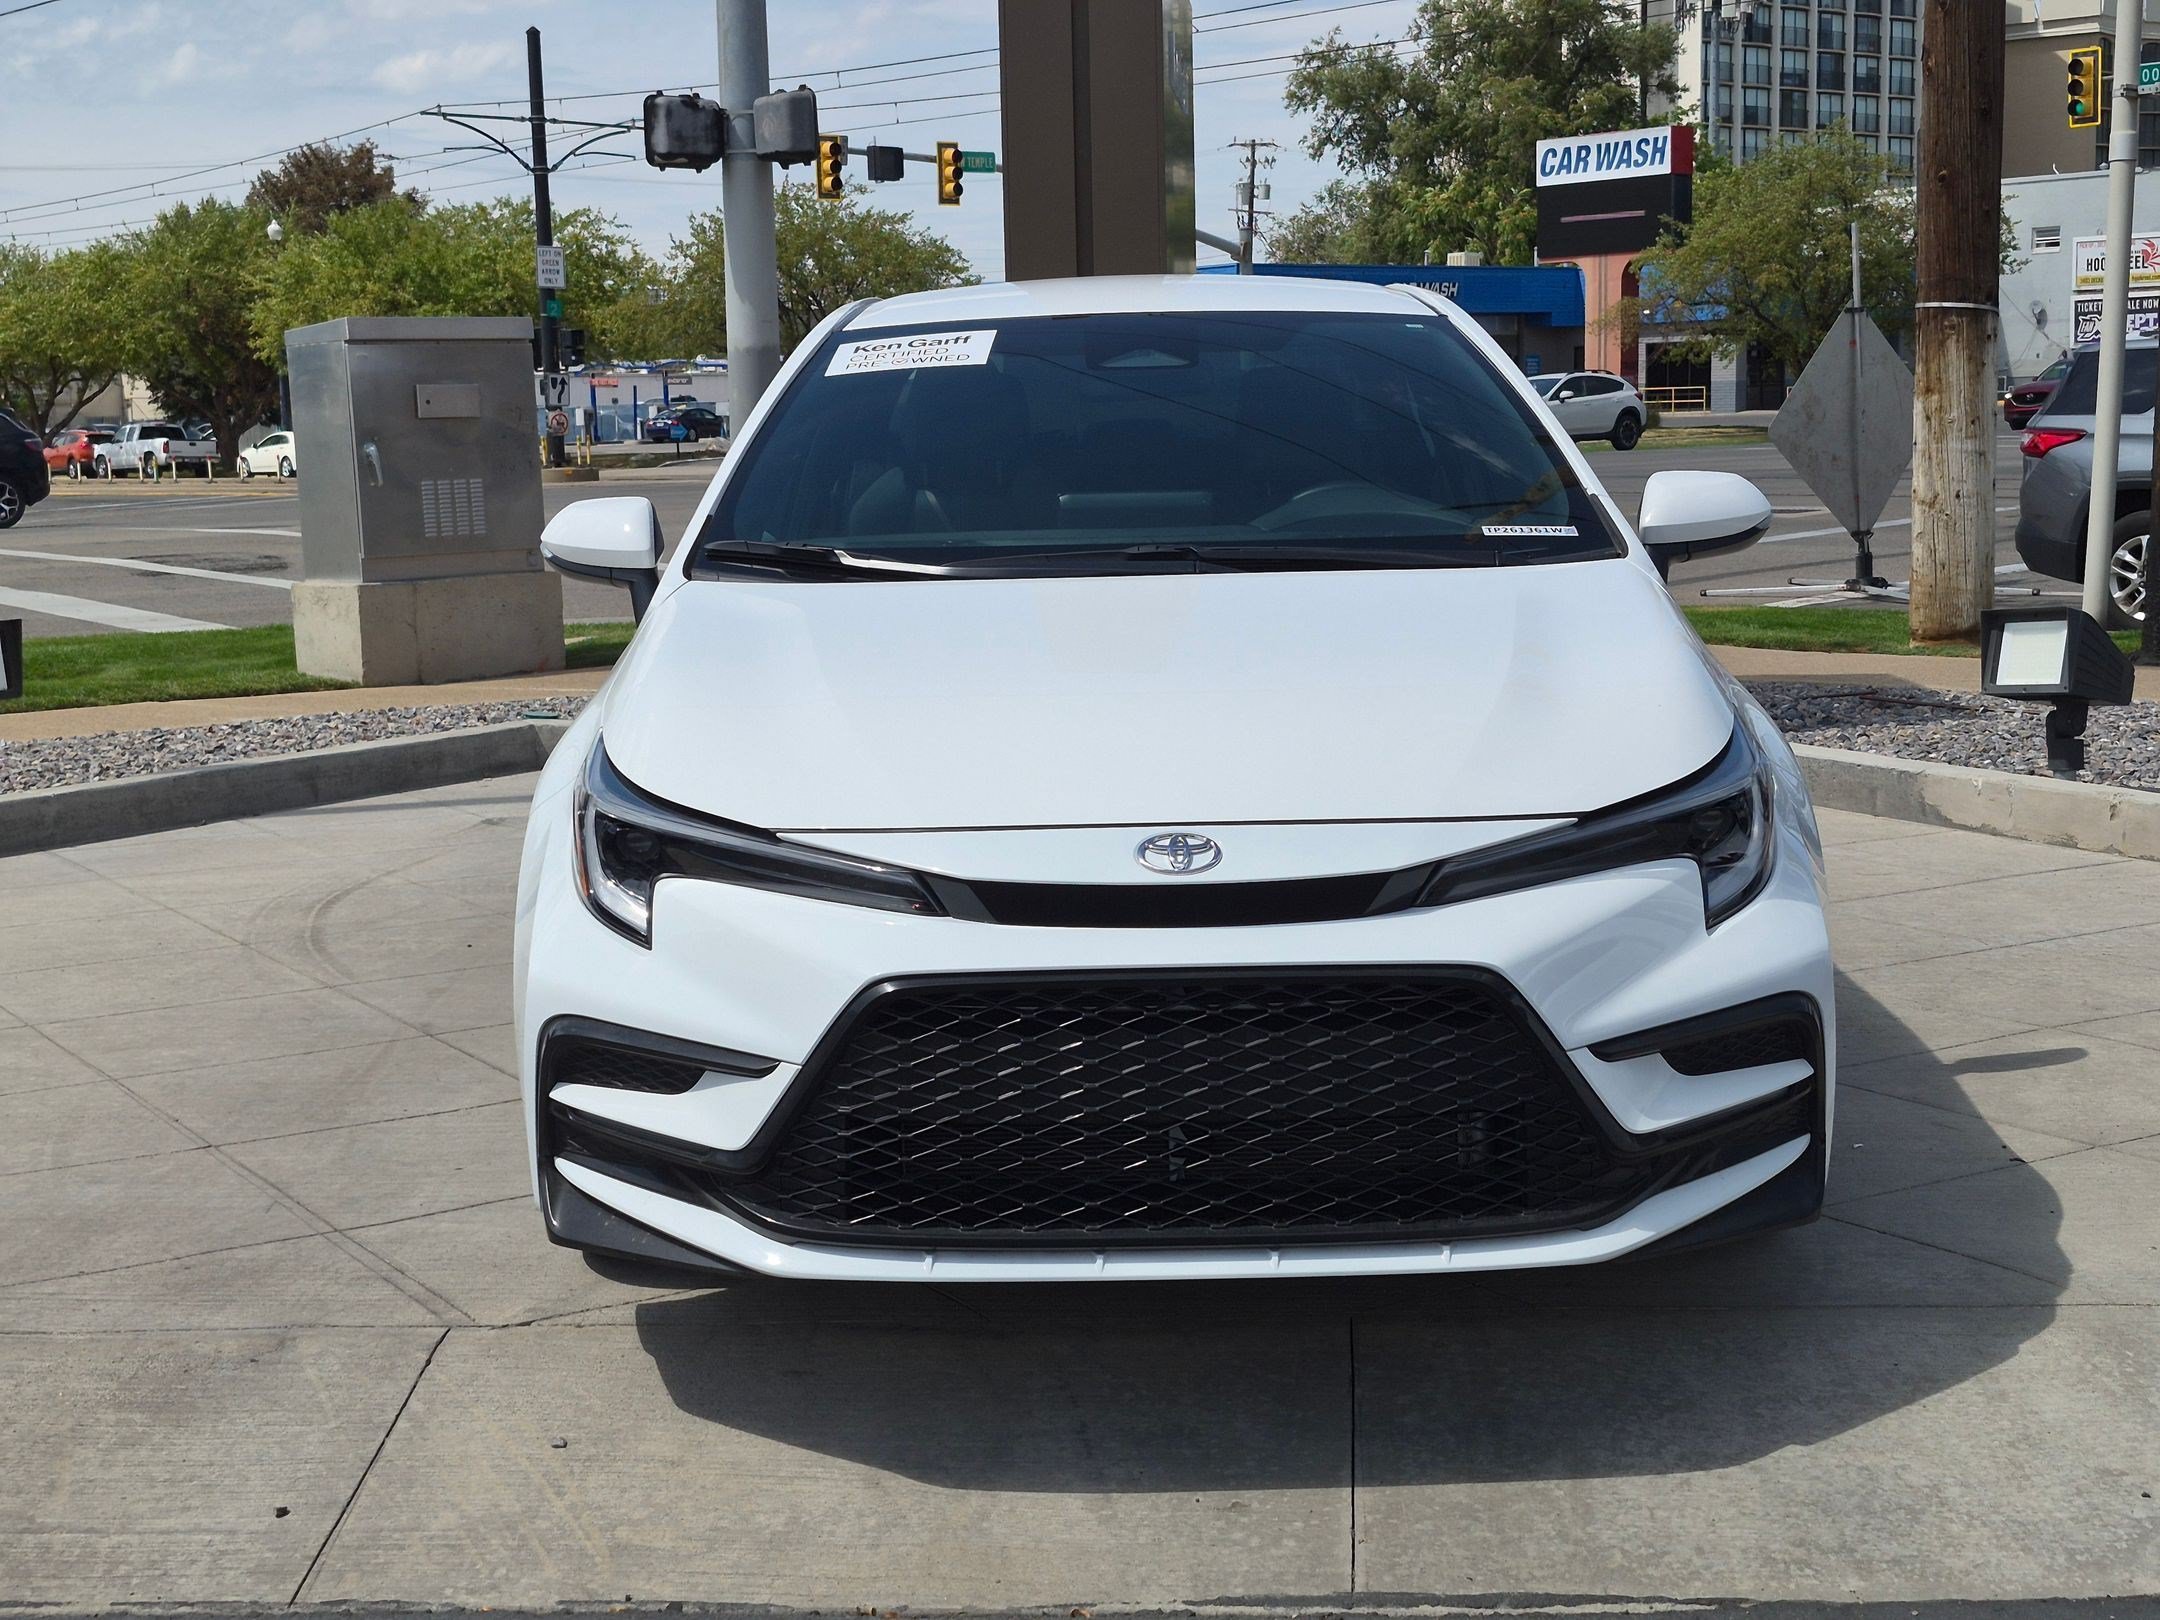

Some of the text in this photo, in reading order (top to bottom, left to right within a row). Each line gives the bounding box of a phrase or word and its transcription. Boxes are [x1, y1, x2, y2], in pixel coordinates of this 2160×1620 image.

[2142, 68, 2159, 82] 00
[967, 157, 993, 168] TEMPLE
[1540, 135, 1668, 177] CAR WASH
[539, 249, 552, 257] LEFT
[2086, 255, 2149, 272] HOO EEL
[543, 277, 558, 285] ONLY
[550, 303, 558, 314] 2
[2077, 298, 2160, 313] TICKET ALE NOW
[853, 335, 972, 354] Ken Garff
[850, 347, 950, 362] CERTIFIED
